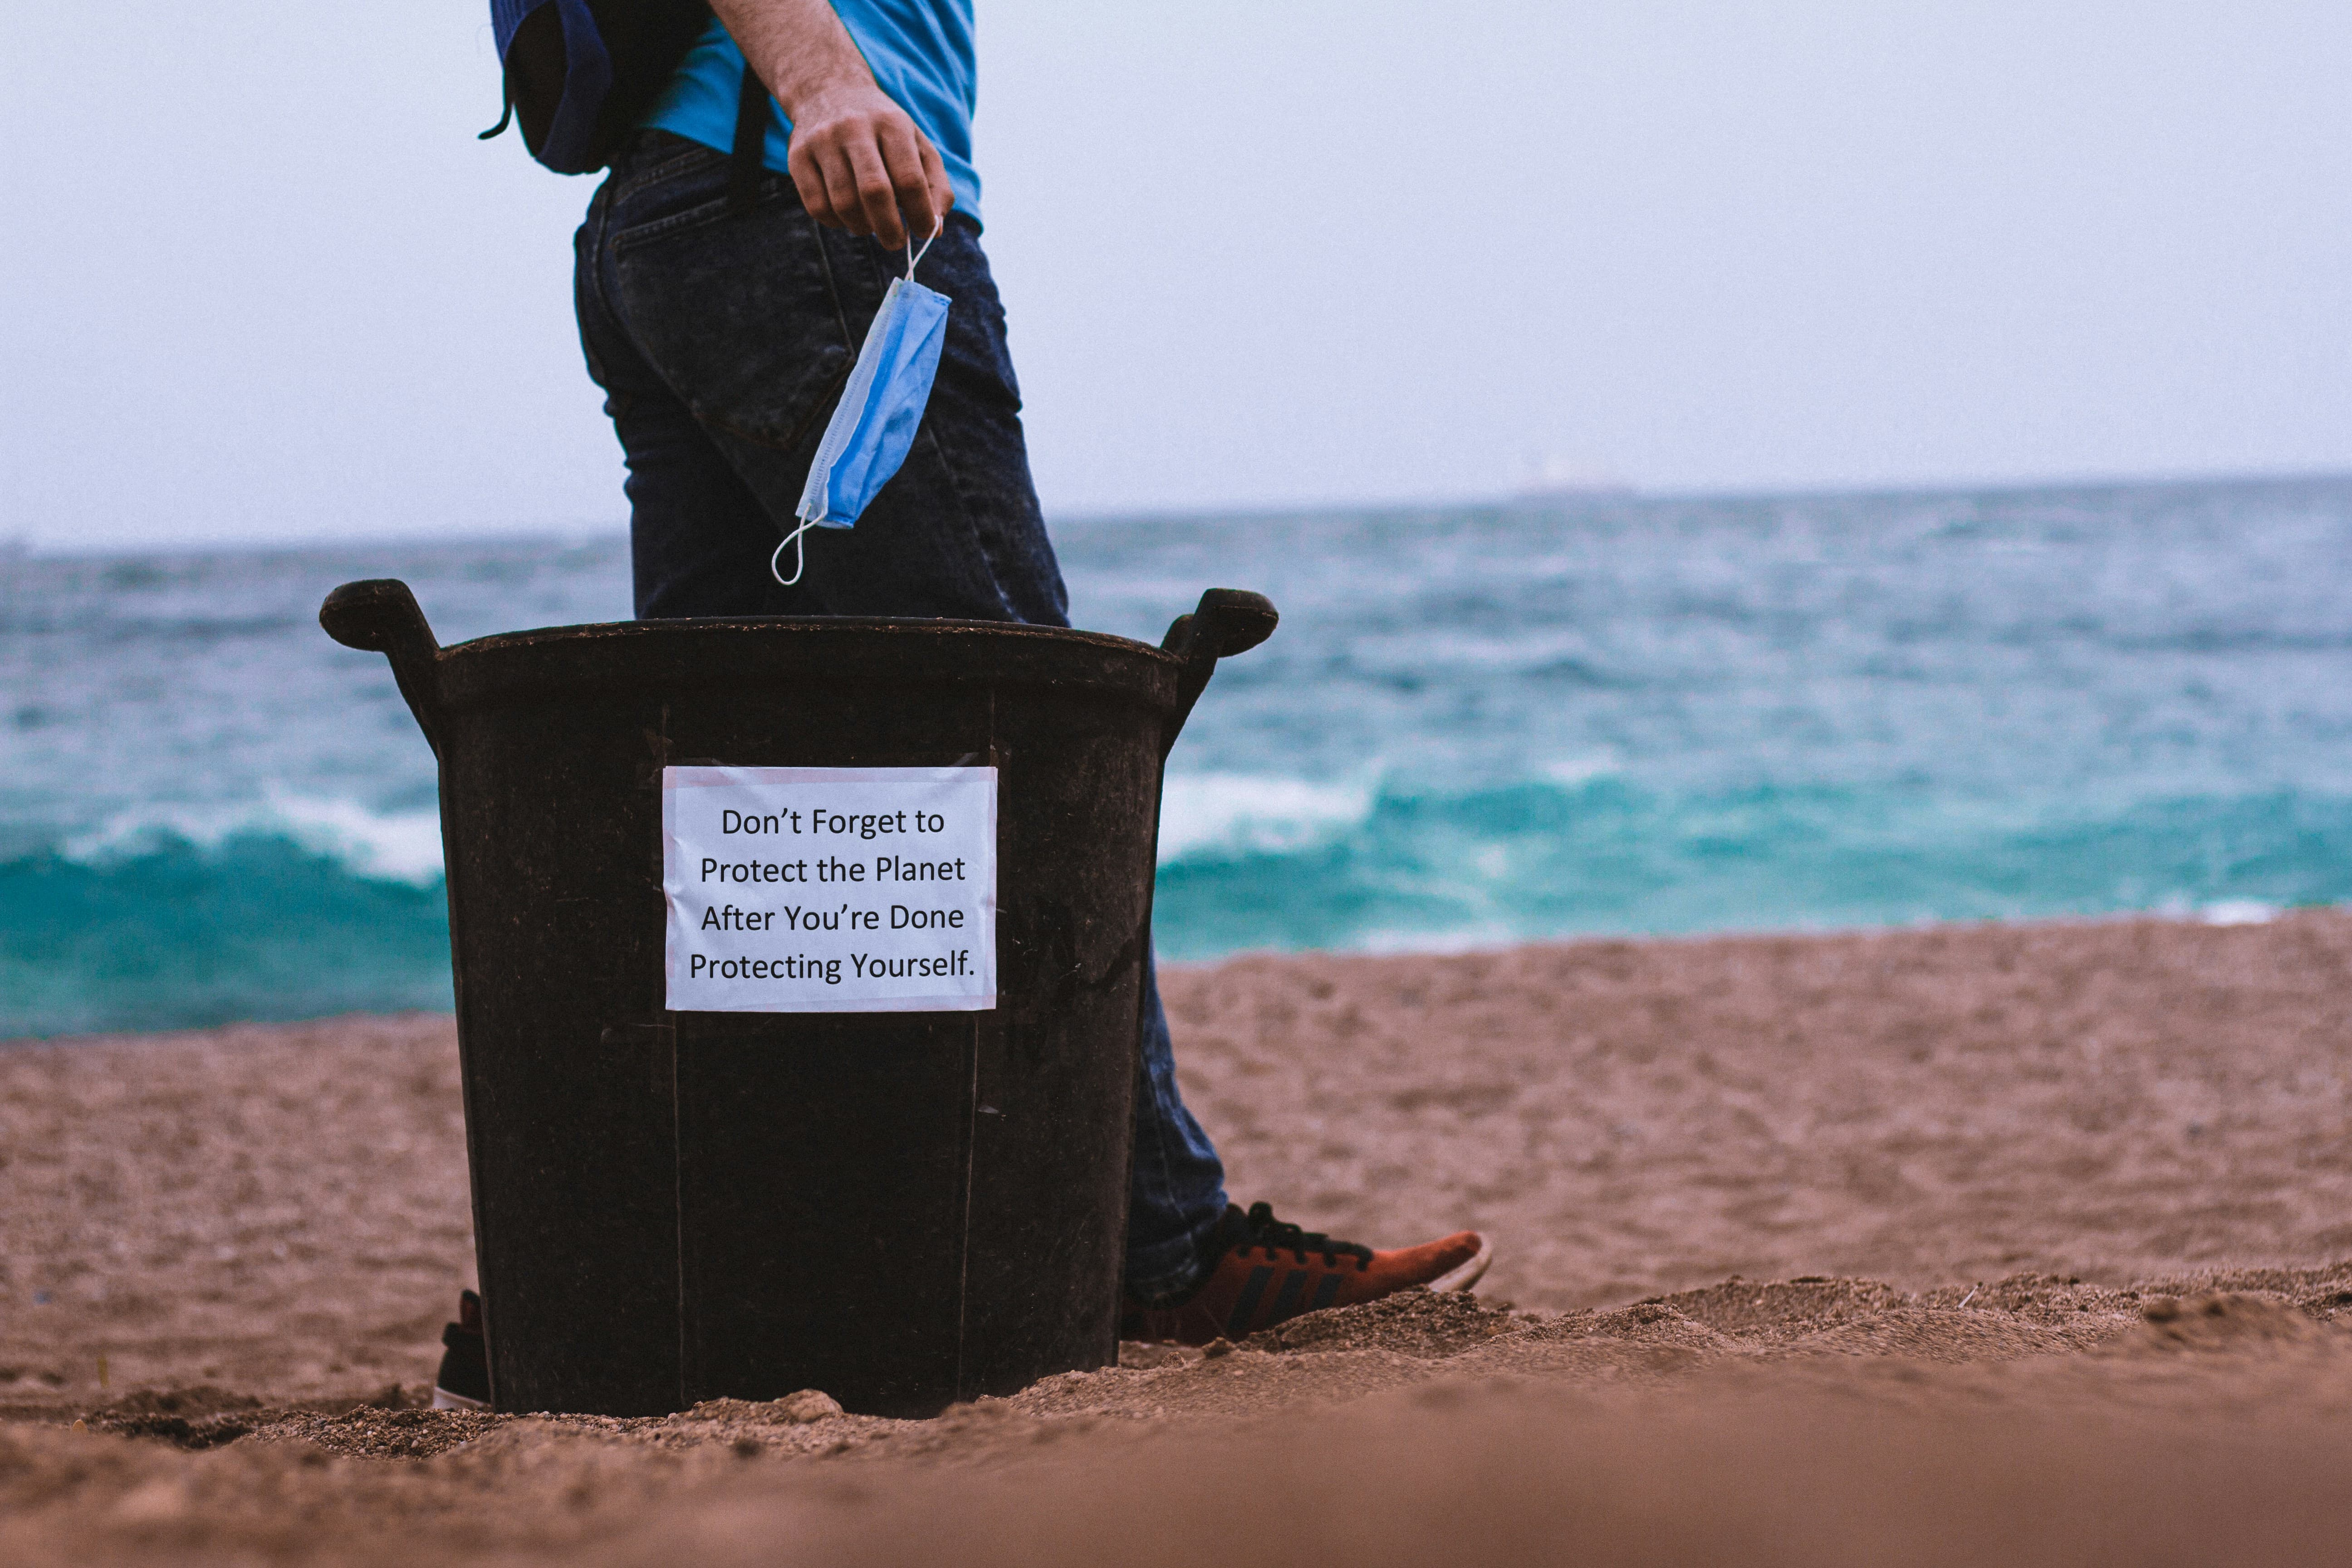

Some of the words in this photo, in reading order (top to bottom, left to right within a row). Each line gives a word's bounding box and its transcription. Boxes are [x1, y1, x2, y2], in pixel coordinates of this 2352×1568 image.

[723, 808, 802, 834] Don’t
[813, 809, 906, 840] Forget
[915, 810, 944, 833] to
[702, 858, 808, 883] Protect
[816, 856, 865, 882] the
[877, 855, 965, 882] Planet
[701, 904, 775, 931] After
[784, 903, 879, 931] You’re
[891, 905, 964, 929] Done
[691, 953, 842, 985] Protecting
[850, 950, 974, 978] Yourself.
